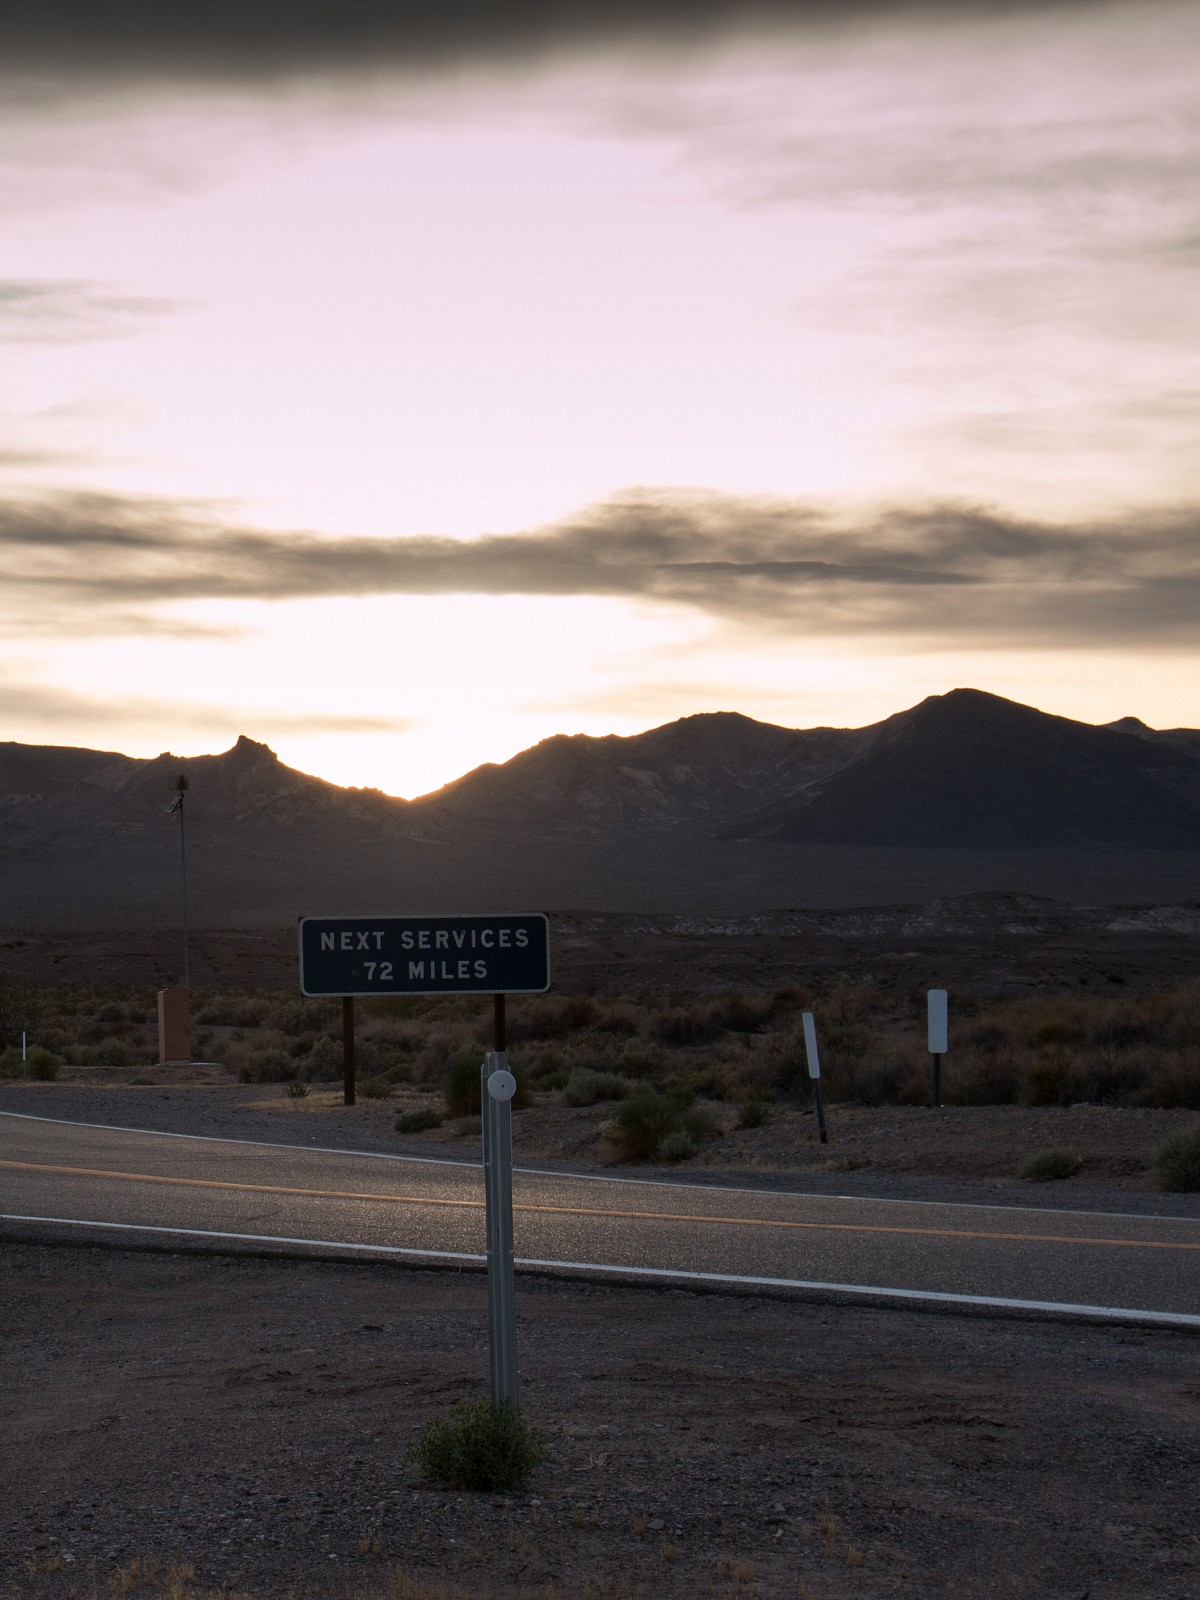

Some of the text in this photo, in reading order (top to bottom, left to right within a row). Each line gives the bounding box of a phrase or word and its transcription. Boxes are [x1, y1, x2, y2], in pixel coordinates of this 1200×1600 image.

[320, 929, 530, 951] NEXT SERVICES
[363, 960, 488, 981] 72 MILES
